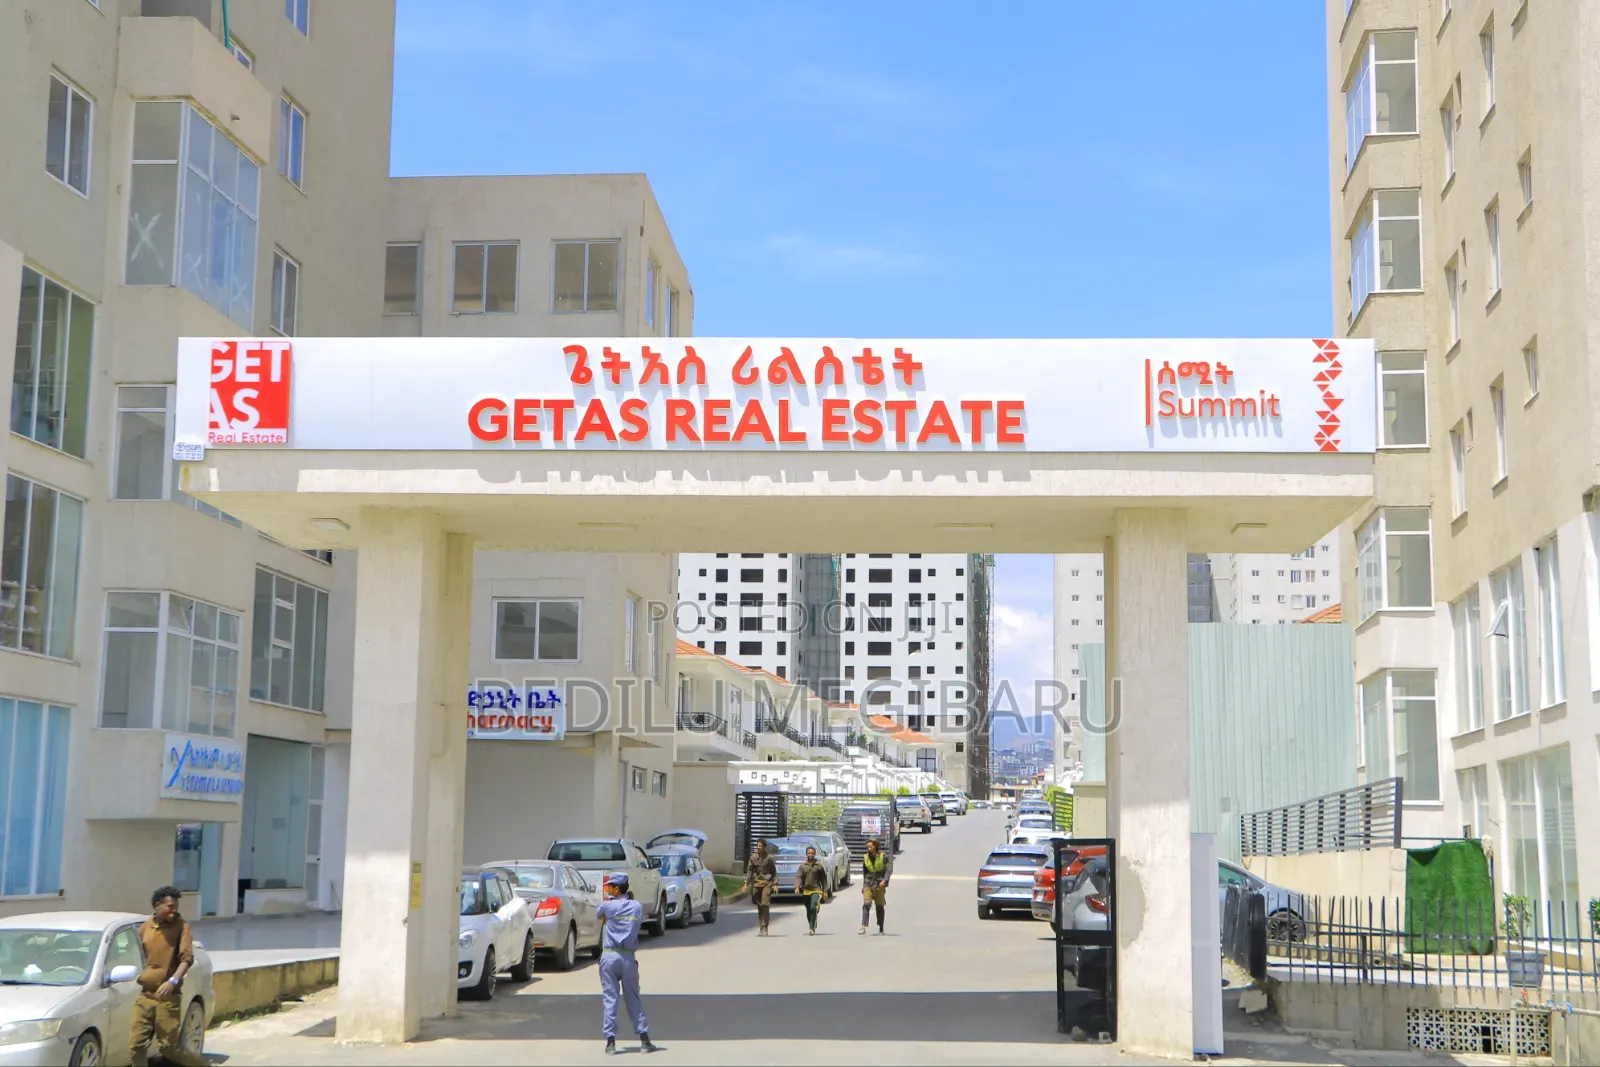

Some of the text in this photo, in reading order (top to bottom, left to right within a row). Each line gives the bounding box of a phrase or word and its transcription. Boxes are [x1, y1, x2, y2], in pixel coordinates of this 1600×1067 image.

[210, 342, 290, 383] GET
[562, 344, 923, 386] ጌትአስ ሪልስቴት
[1157, 360, 1234, 385] ሰሚት
[208, 387, 261, 431] AS
[1158, 389, 1281, 417] Summit
[208, 431, 284, 444] Real Estate
[467, 398, 1025, 444] GETAS REAL ESTATE
[467, 711, 553, 733] harmacy
